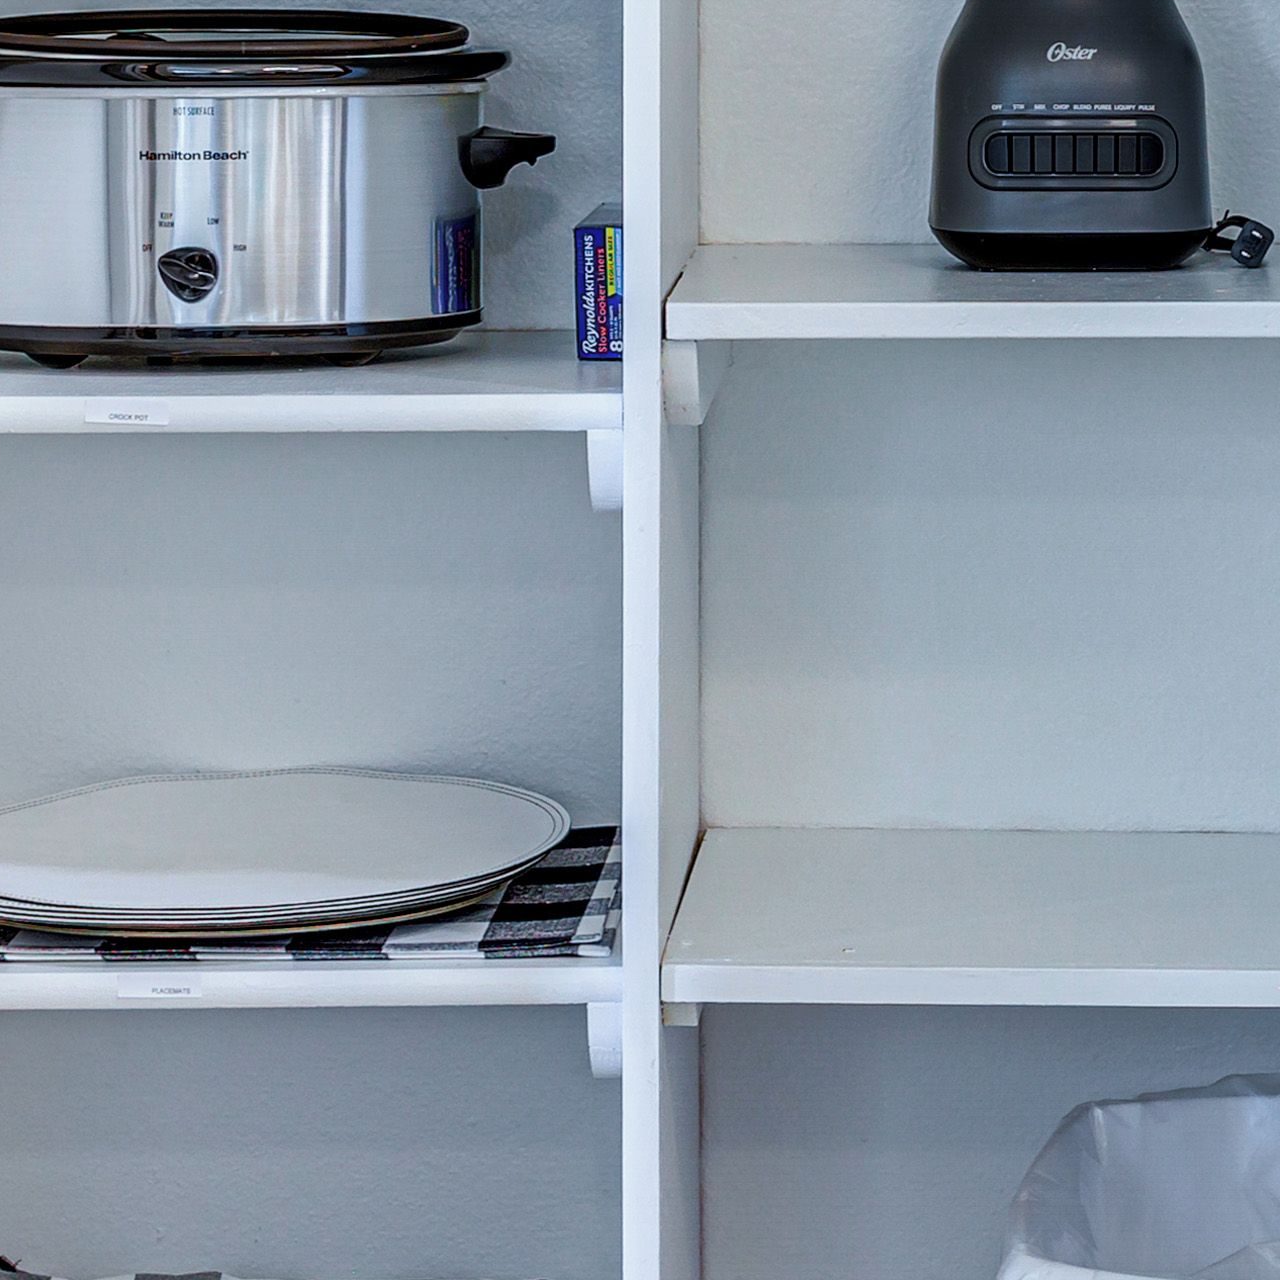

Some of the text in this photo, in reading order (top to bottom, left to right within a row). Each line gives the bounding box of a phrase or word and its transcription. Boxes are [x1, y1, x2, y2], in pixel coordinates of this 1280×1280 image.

[1046, 41, 1098, 63] Oster
[1052, 103, 1070, 111] CHOP
[139, 150, 247, 161] Hamilton Beach
[582, 235, 599, 354] Reynolds KITCHENS
[596, 248, 608, 353] Slow Cooker Liners
[610, 340, 623, 353] 8
[108, 413, 132, 421] CROCK
